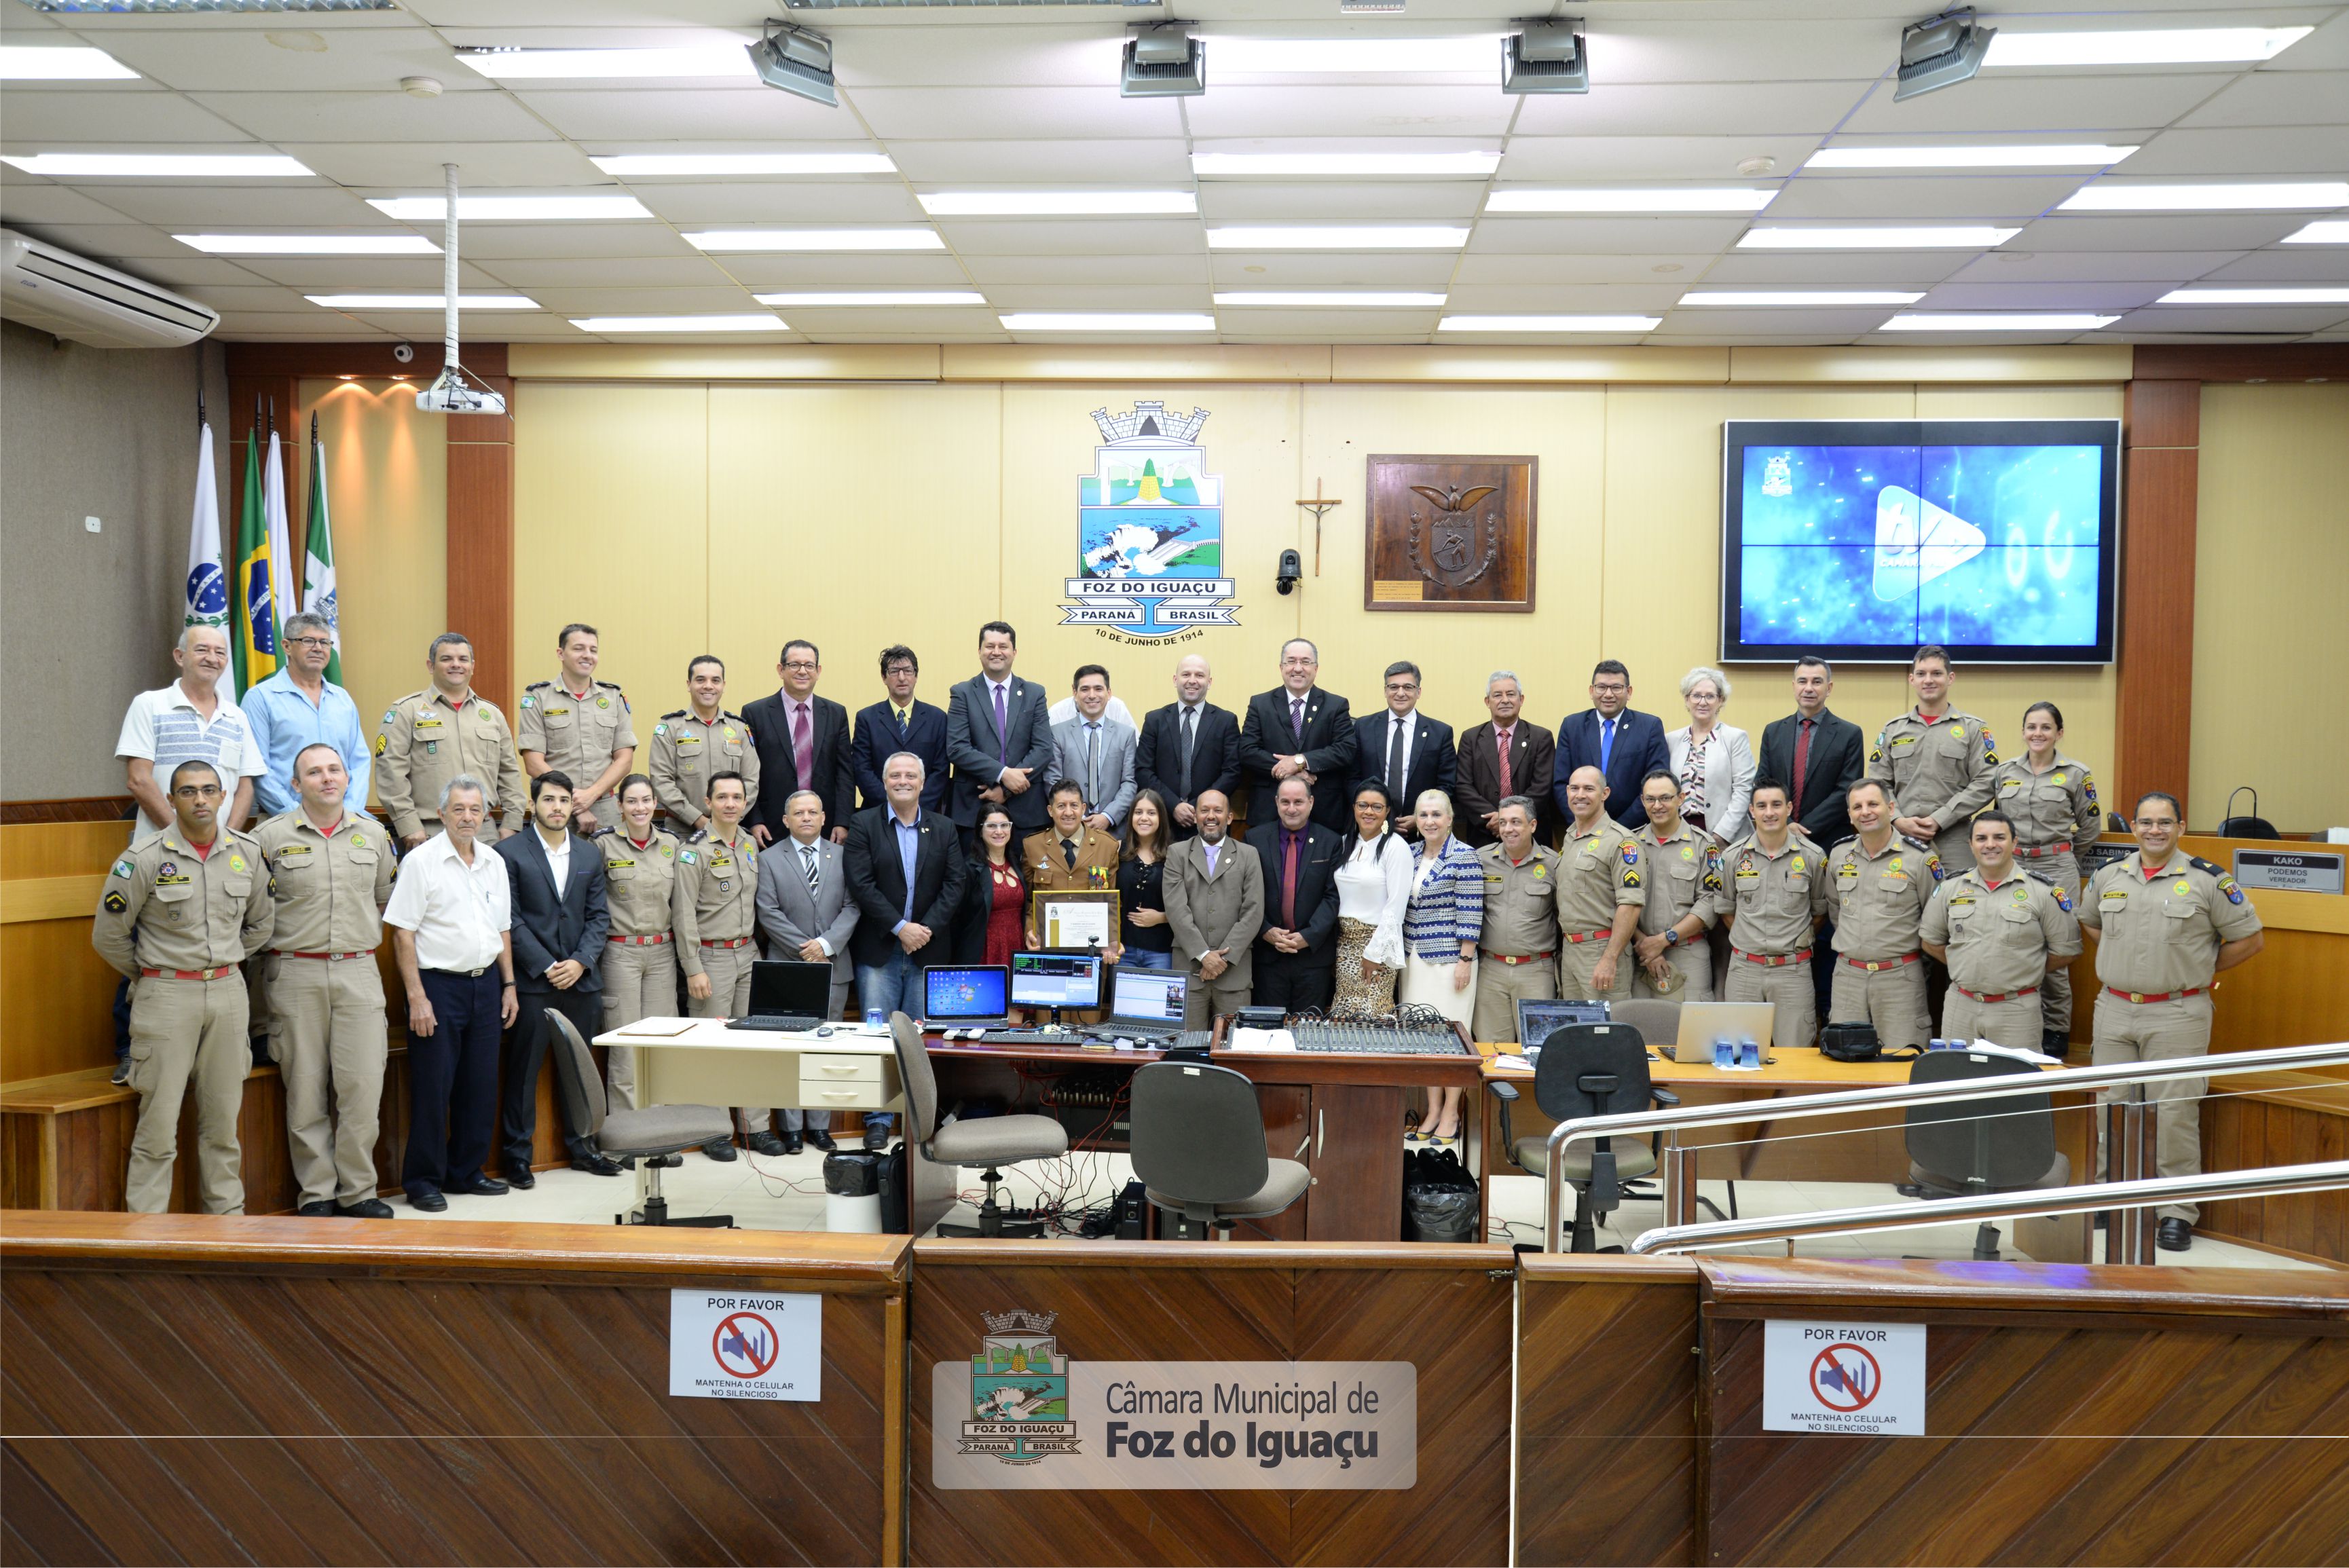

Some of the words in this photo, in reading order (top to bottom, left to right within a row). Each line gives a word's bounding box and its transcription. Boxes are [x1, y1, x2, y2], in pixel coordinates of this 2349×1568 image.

[1083, 582, 1115, 593] FOZ
[1122, 582, 1145, 593] DO
[1151, 582, 1217, 596] IGUAÇU
[1081, 609, 1136, 620] PARANÁ
[1169, 611, 1219, 620] BRASIL
[1095, 628, 1106, 637] 10
[1109, 633, 1122, 643] DE
[1124, 637, 1161, 646] JUNHO
[1163, 637, 1177, 646] DE
[1179, 629, 1204, 643] 1914
[2273, 857, 2303, 865] KAKO
[2268, 868, 2308, 876] PODEMOS
[707, 1298, 736, 1309] POR
[740, 1299, 784, 1311] FAVOR
[1804, 1329, 1834, 1340] POR
[1839, 1330, 1887, 1342] FAVOR
[695, 1379, 743, 1388] MANTENHA
[754, 1381, 794, 1390] CELULAR
[726, 1389, 777, 1398] SILENCIOSO
[1791, 1413, 1842, 1422] MANTENHA
[1854, 1415, 1897, 1423] CELULAR
[1824, 1424, 1879, 1432] SILENCIOSO
